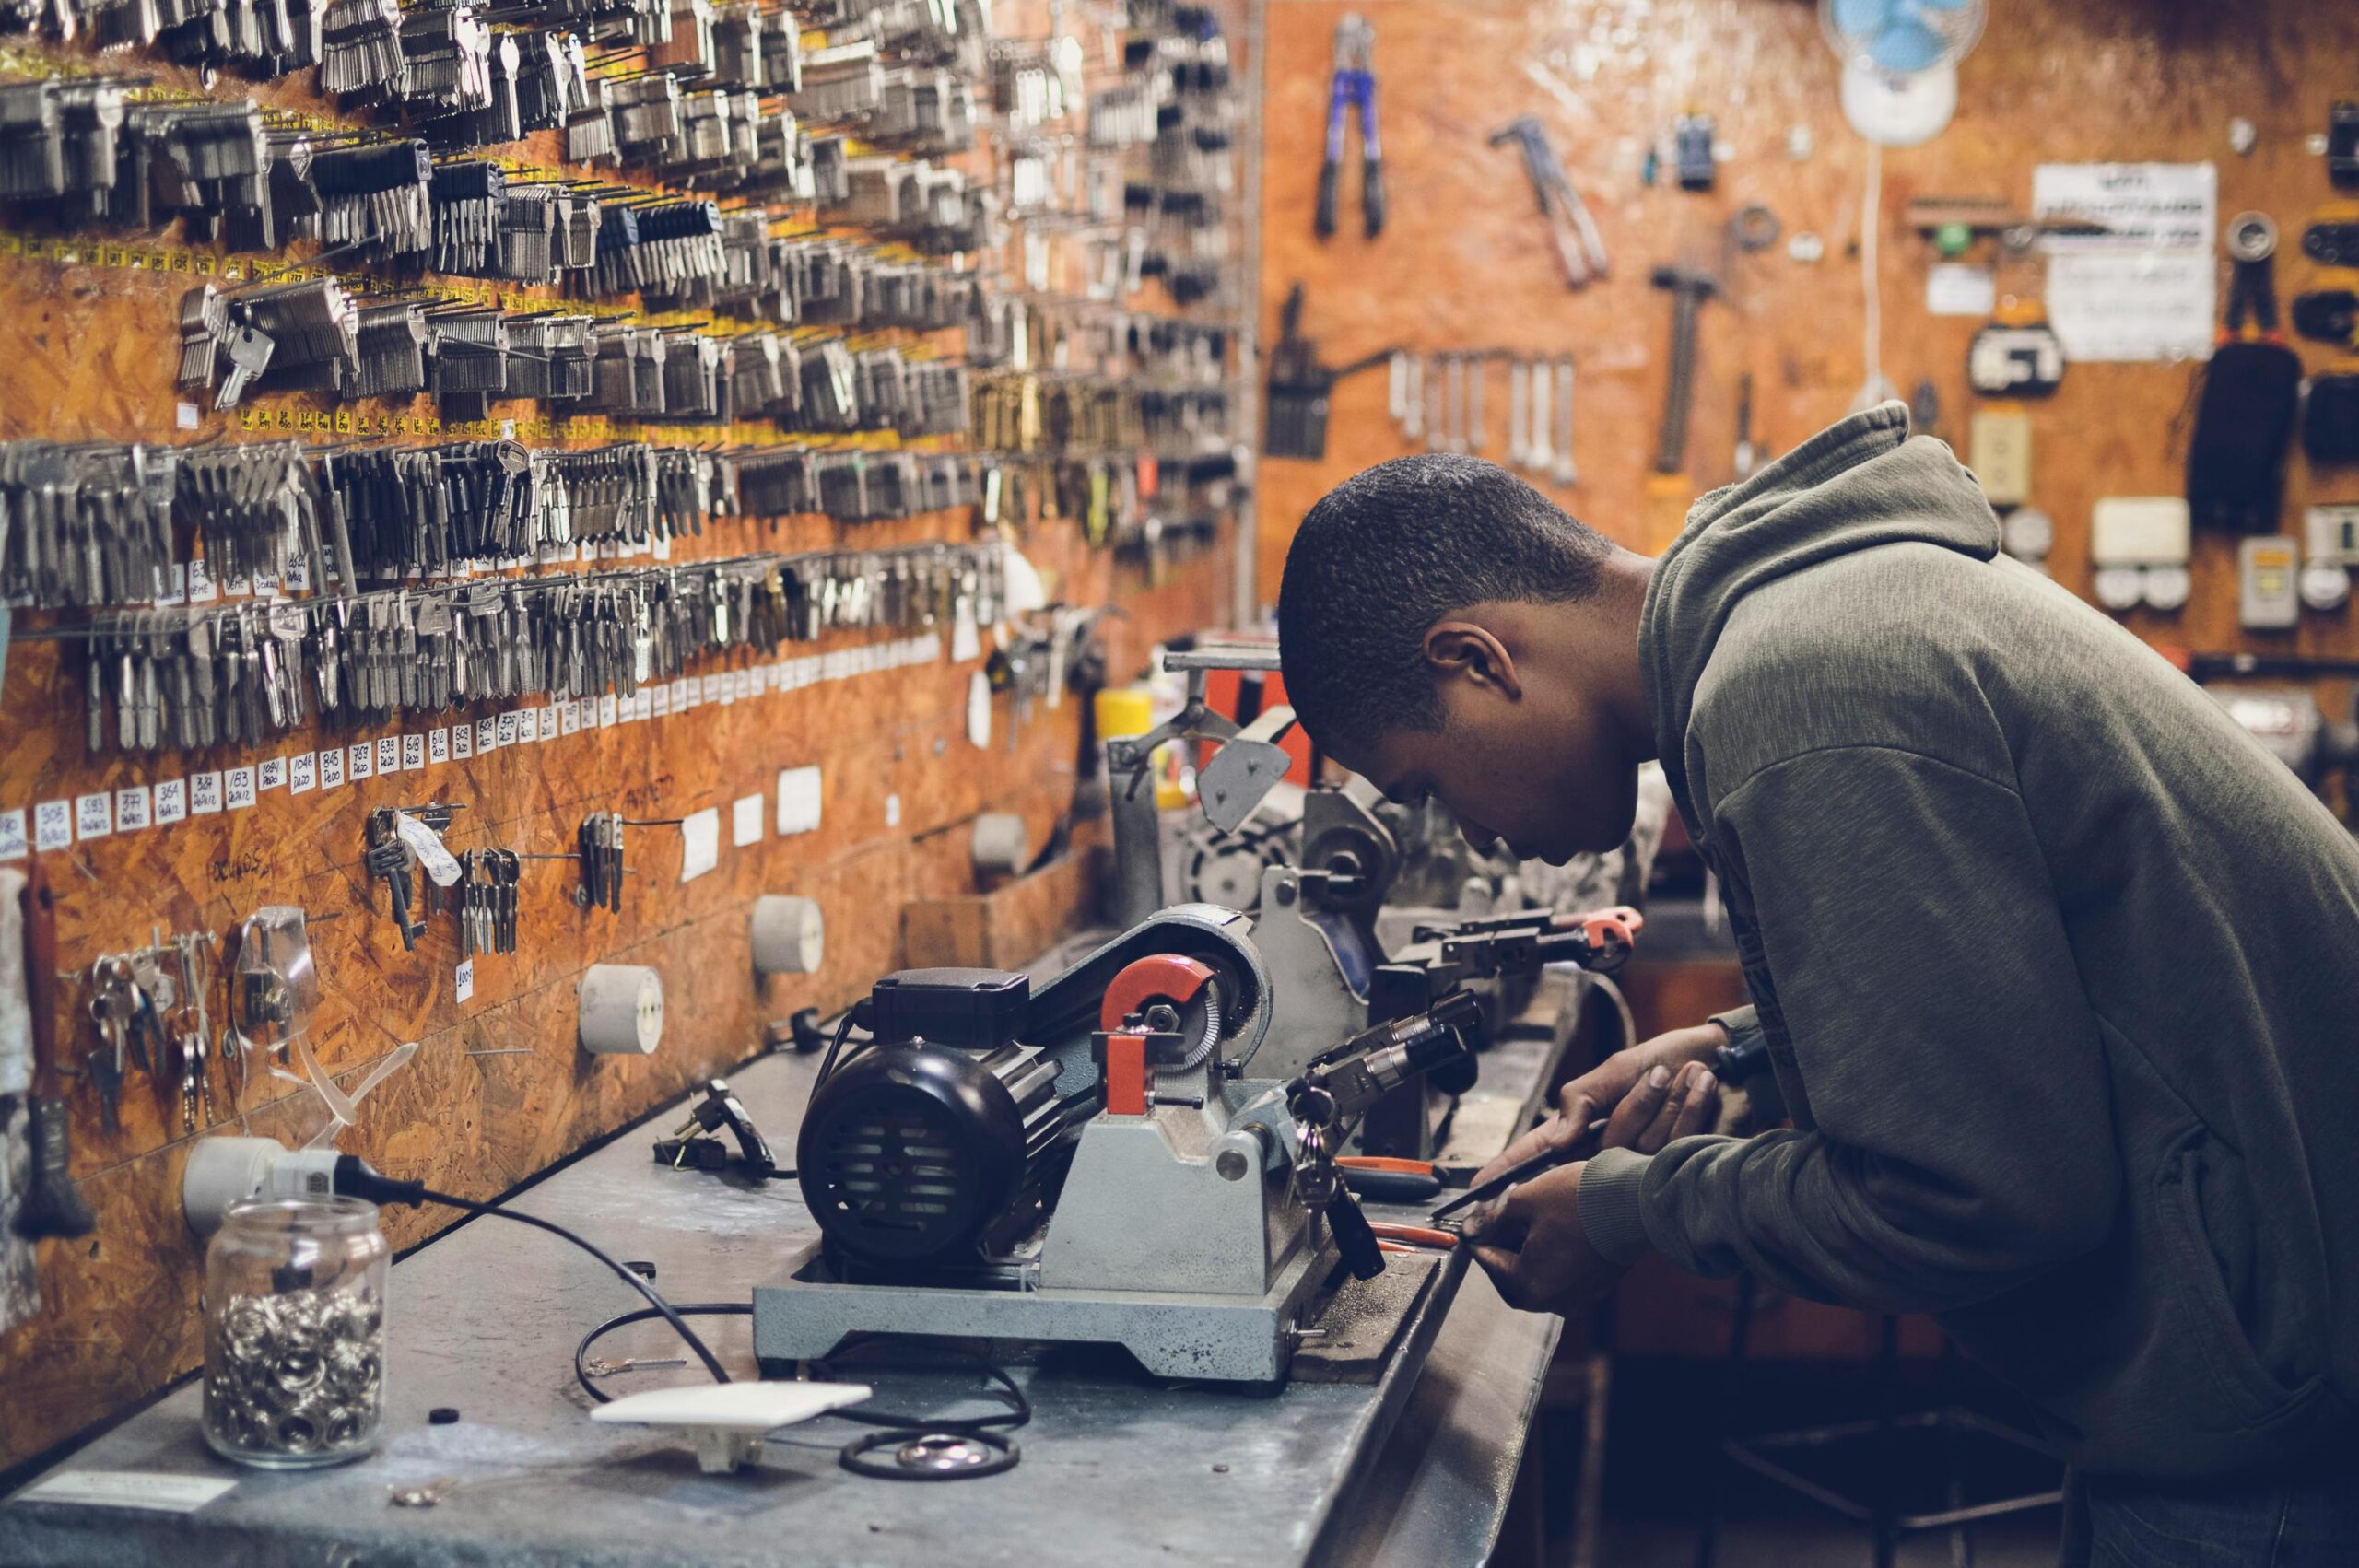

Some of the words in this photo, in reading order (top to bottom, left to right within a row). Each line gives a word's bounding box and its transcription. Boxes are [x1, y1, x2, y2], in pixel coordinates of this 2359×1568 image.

[406, 736, 420, 751] 618
[432, 731, 444, 744] 612
[353, 746, 368, 762] 759
[381, 739, 394, 753] 639
[294, 755, 312, 772] 1046
[323, 751, 338, 767] 845
[229, 771, 249, 787] 183
